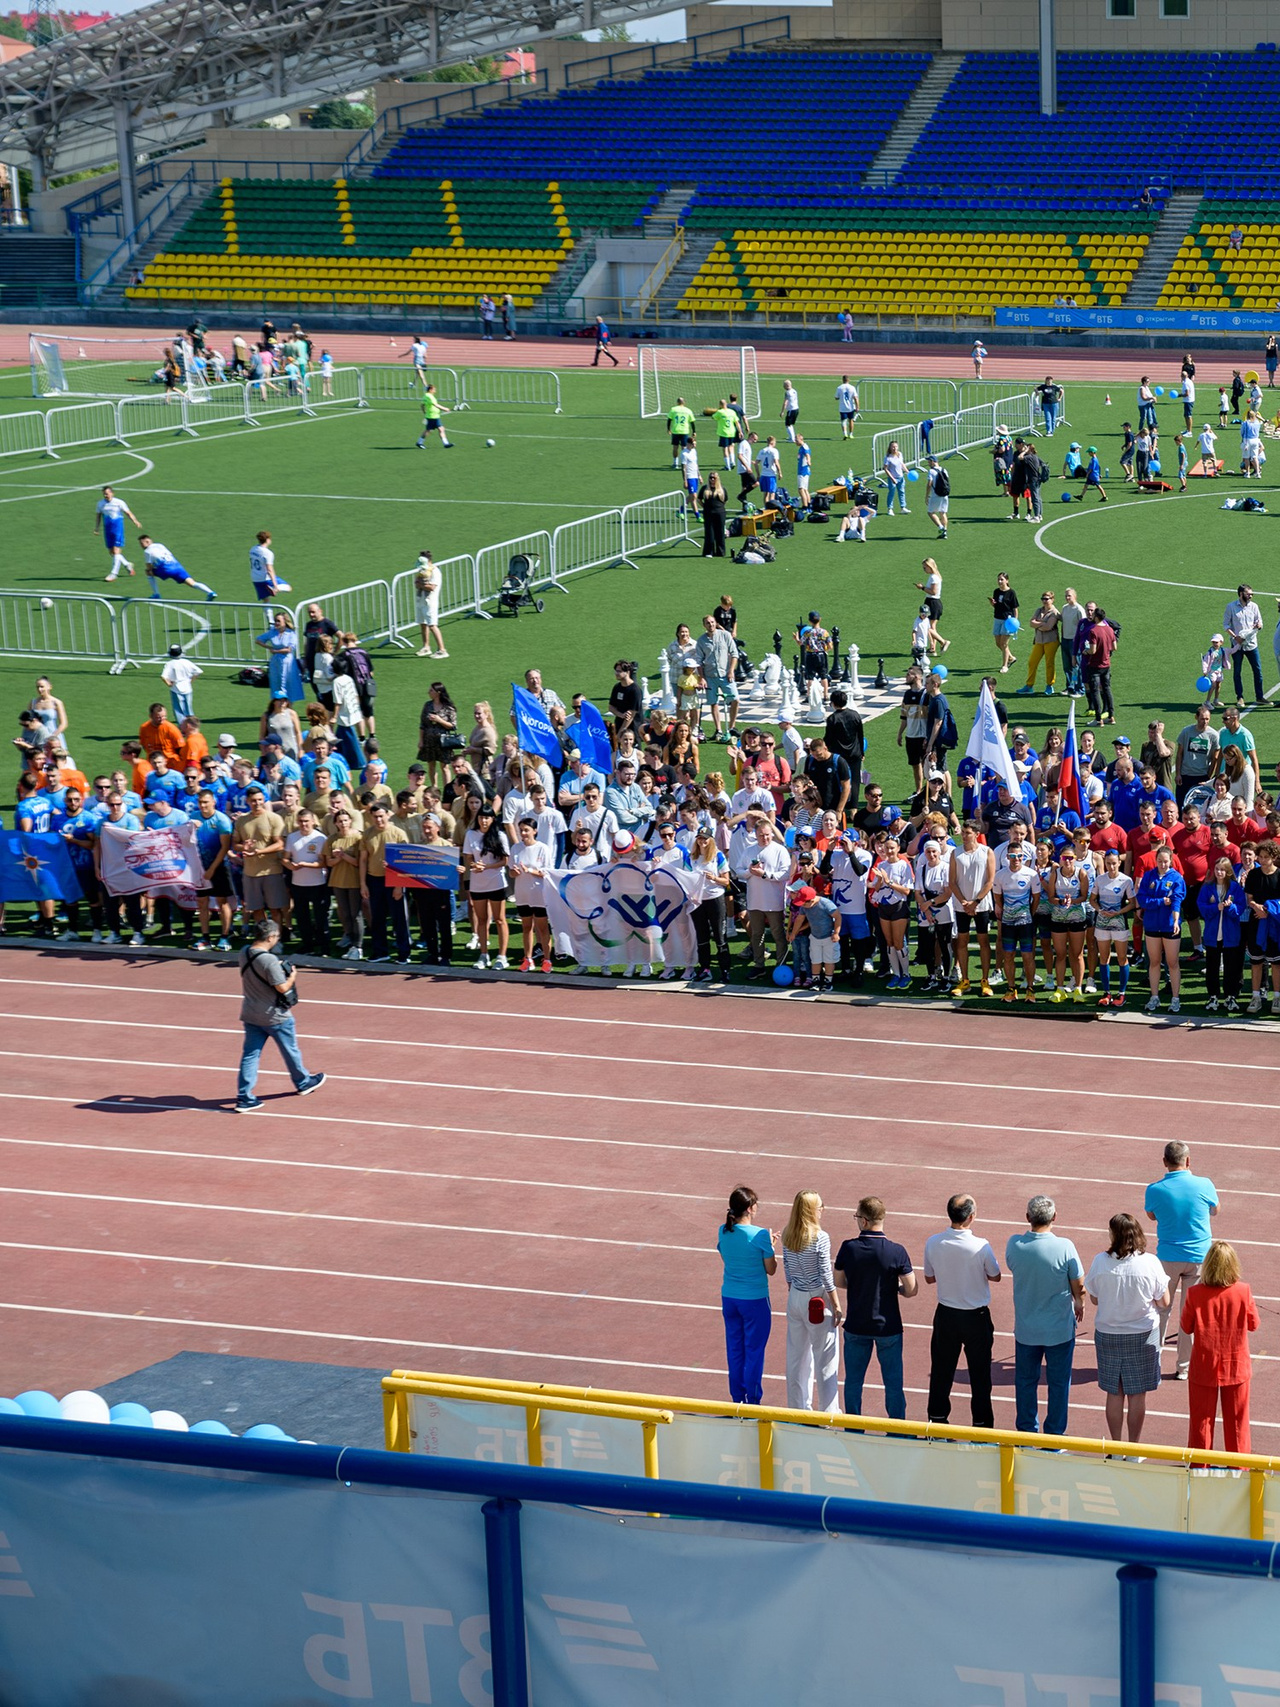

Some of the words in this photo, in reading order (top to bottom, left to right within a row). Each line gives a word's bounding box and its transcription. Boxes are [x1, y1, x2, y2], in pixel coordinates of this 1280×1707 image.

[1014, 313, 1030, 322] ВТБ
[1054, 314, 1071, 323] ВТБ
[1096, 314, 1113, 323] ВТБ
[1145, 316, 1175, 324] открытие
[1199, 316, 1218, 326] ВТБ
[1242, 317, 1273, 325] открытие
[674, 415, 686, 424] 12
[233, 794, 247, 809] 11
